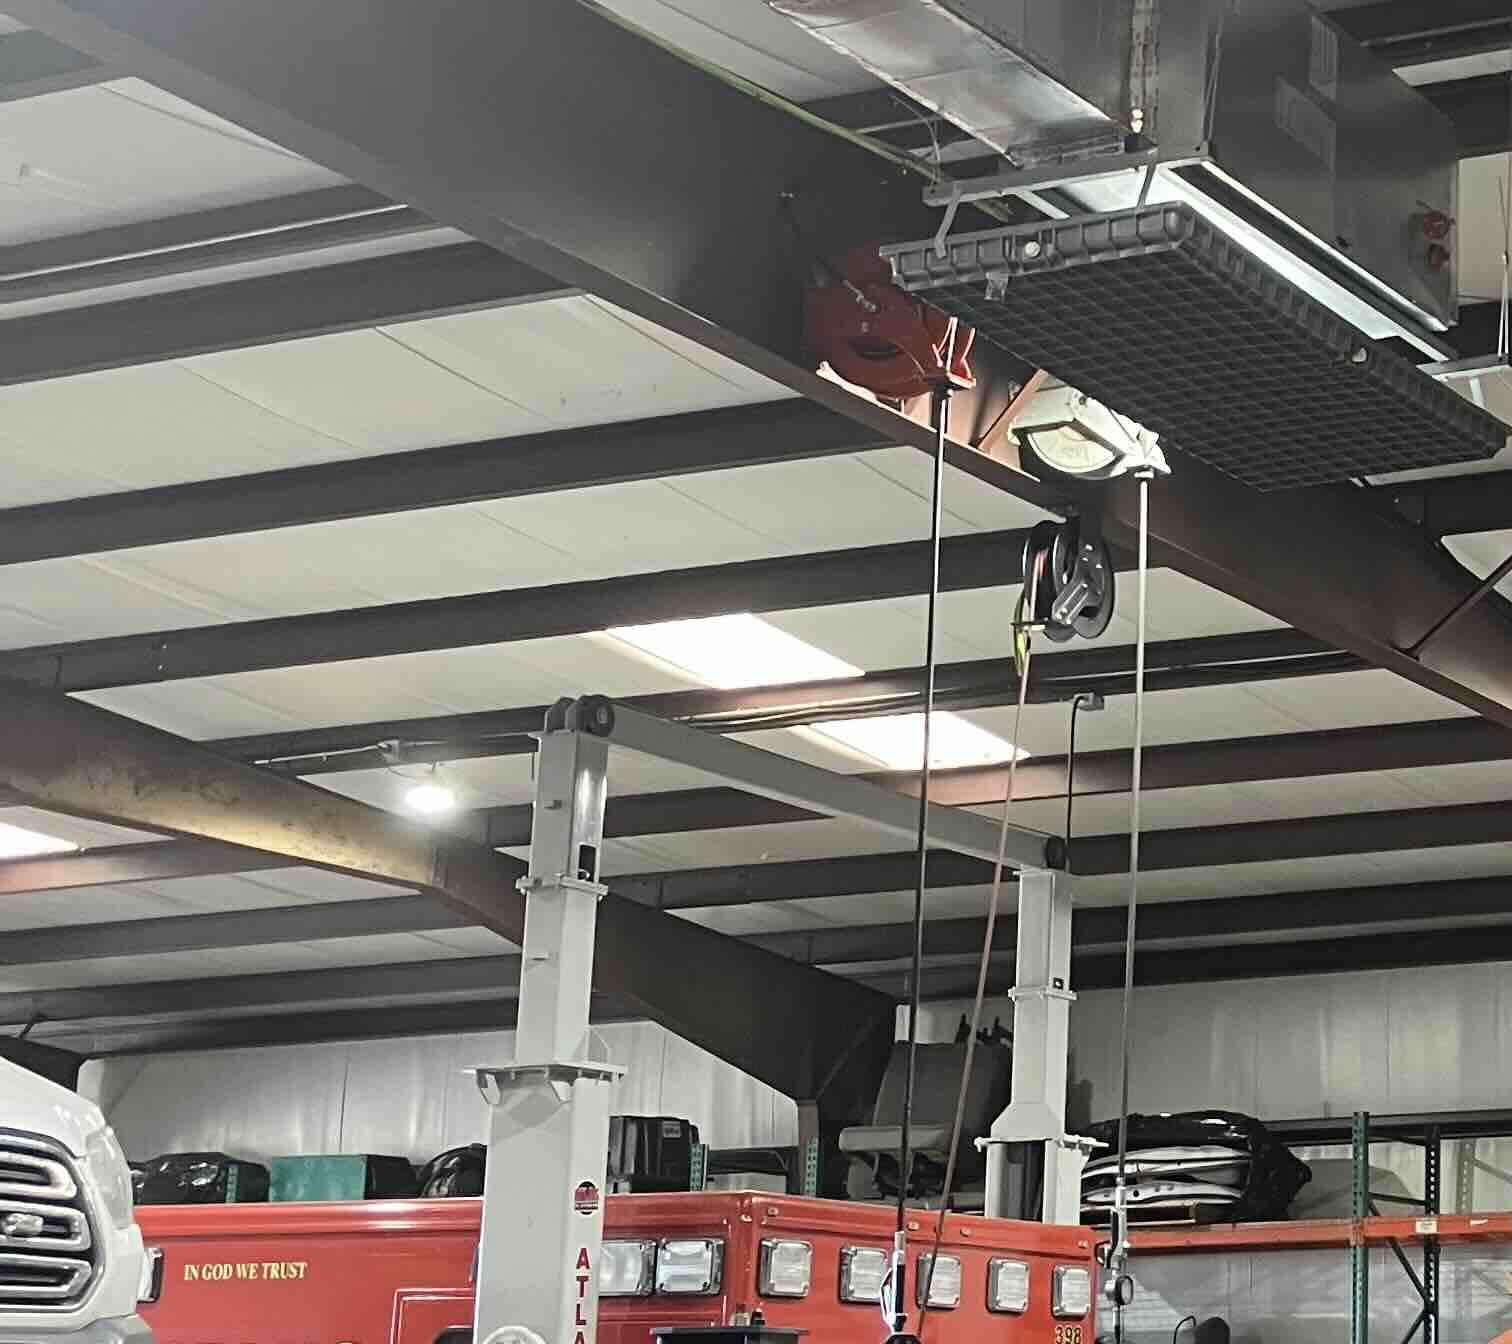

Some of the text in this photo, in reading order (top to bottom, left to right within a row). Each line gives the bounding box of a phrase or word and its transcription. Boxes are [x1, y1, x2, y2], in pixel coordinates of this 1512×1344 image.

[184, 1261, 308, 1280] IN GOD WE TRUST
